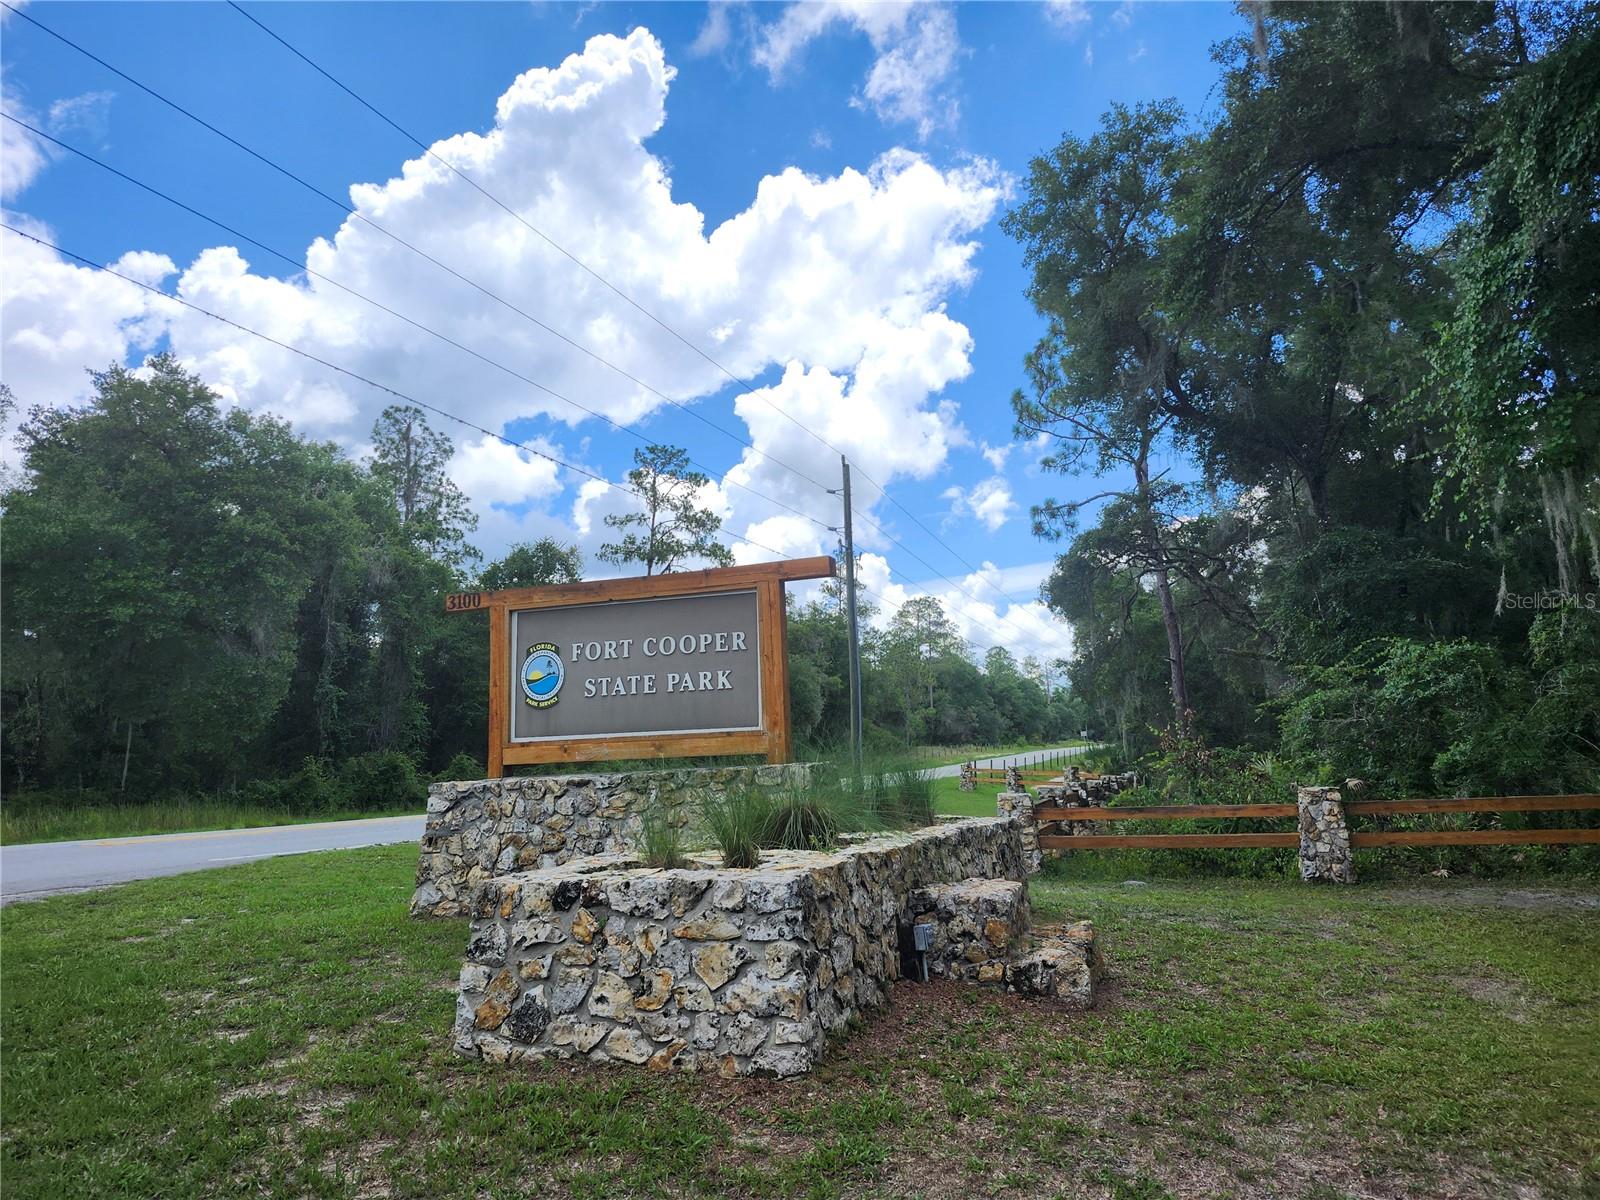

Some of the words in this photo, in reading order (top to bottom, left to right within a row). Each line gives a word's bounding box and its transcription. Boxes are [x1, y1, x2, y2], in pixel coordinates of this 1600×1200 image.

[448, 594, 481, 610] 3100
[529, 643, 556, 653] FLORIDA
[571, 639, 633, 662] FORT
[643, 631, 747, 657] COOPER
[584, 674, 656, 698] STATE
[667, 670, 733, 693] PARK
[526, 697, 539, 707] PARK
[539, 696, 558, 708] SERVICE
